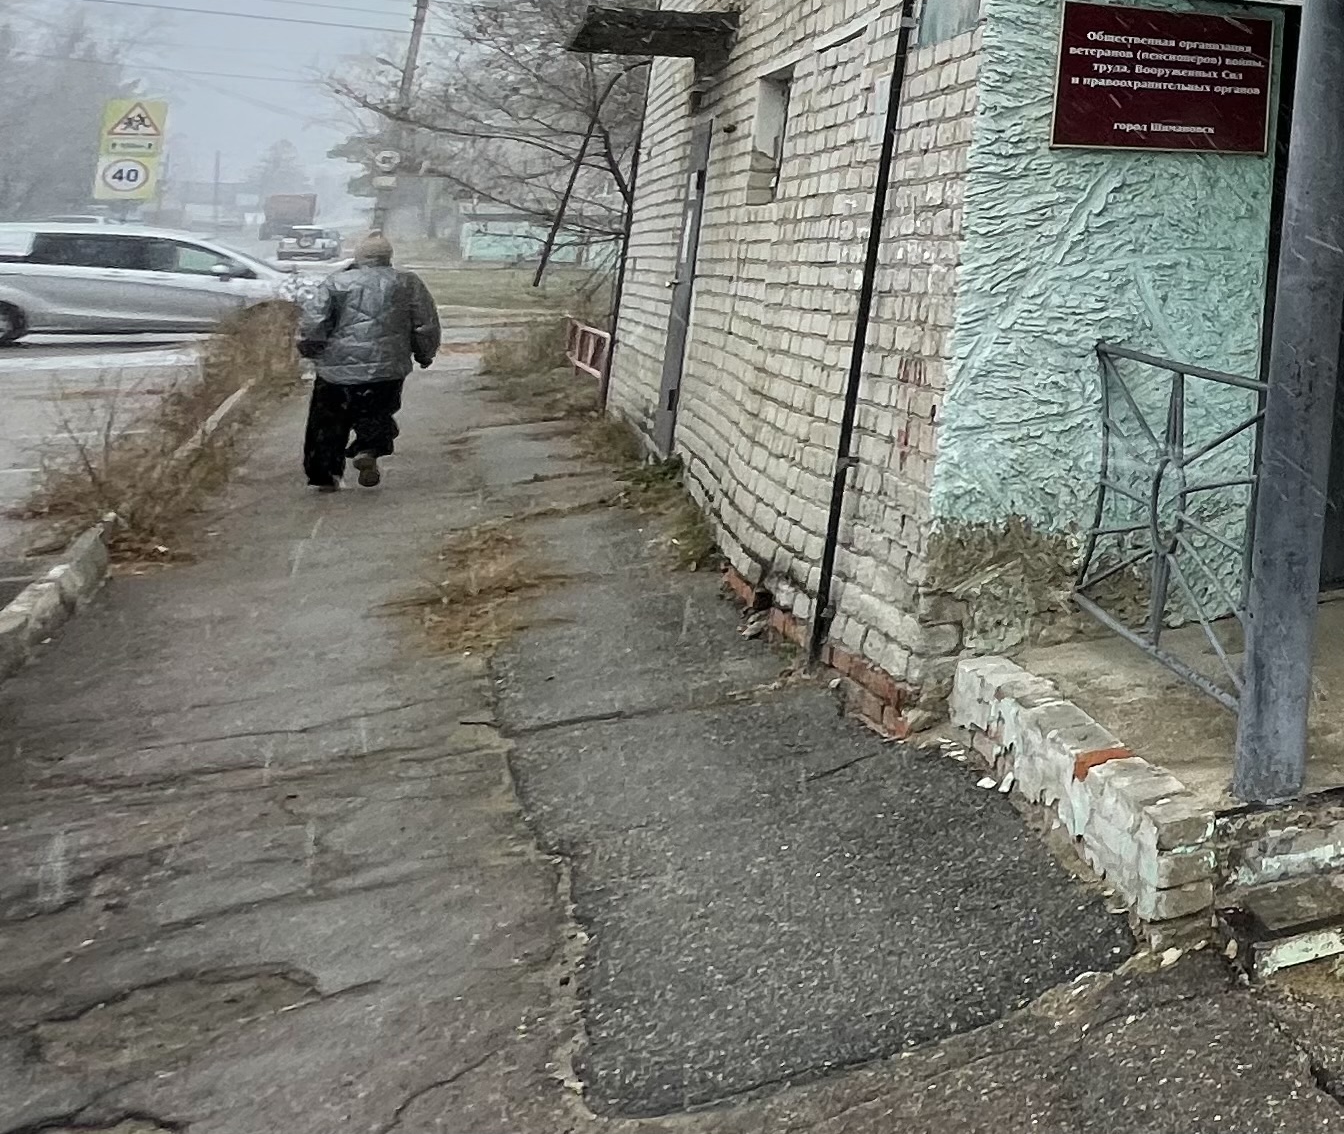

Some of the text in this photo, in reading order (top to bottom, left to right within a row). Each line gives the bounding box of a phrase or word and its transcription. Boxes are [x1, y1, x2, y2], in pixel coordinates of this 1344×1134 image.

[1087, 31, 1252, 52] Общественная организация
[1069, 46, 1133, 58] ветеранов
[1137, 49, 1222, 65] (пенсионеров)
[1222, 70, 1242, 80] Сил
[1083, 77, 1211, 92] правоохранительных
[1214, 85, 1260, 95] органов
[1113, 122, 1214, 134] город Шимановск
[112, 168, 139, 183] 40
